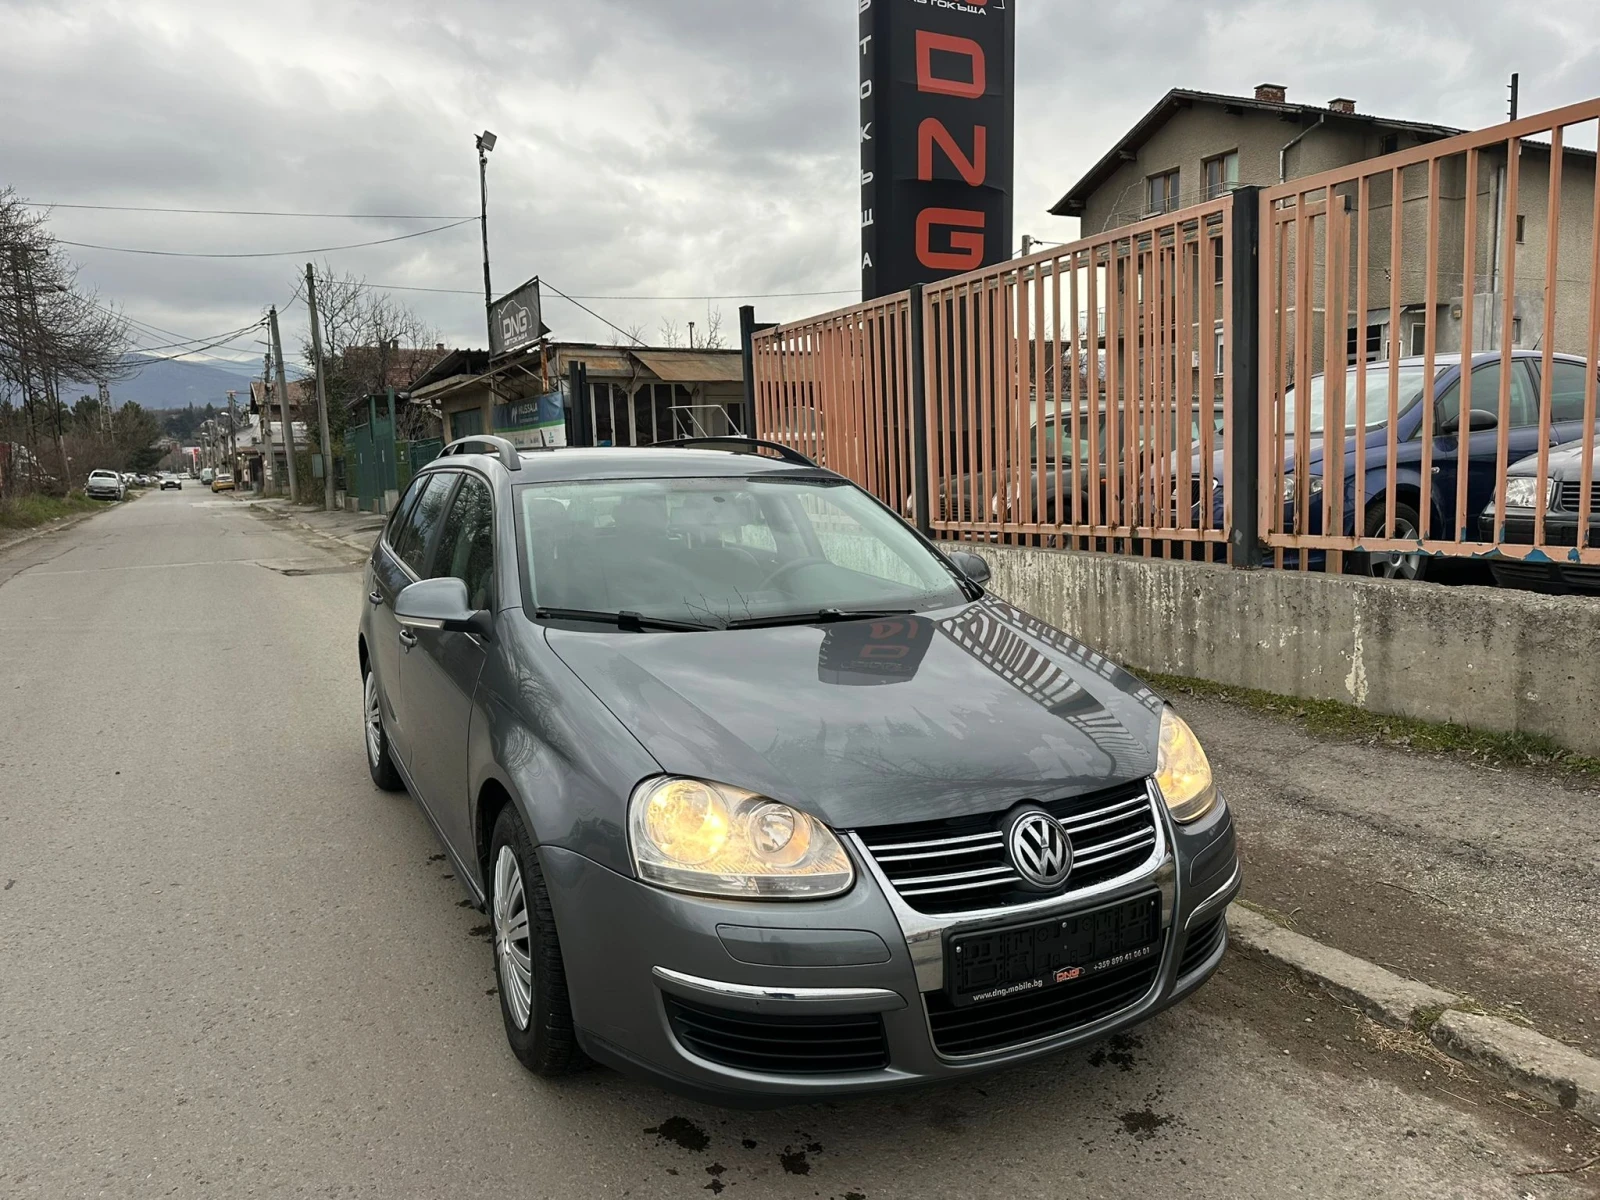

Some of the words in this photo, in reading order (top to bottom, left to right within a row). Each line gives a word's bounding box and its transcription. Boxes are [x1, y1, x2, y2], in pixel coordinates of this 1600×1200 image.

[912, 0, 987, 15] ТОКЪЩА
[915, 29, 987, 271] DNG
[503, 309, 527, 340] DNG
[1093, 959, 1111, 970] +359
[1111, 955, 1124, 965] 899
[972, 979, 1043, 1001] www.dng.mobile.bg
